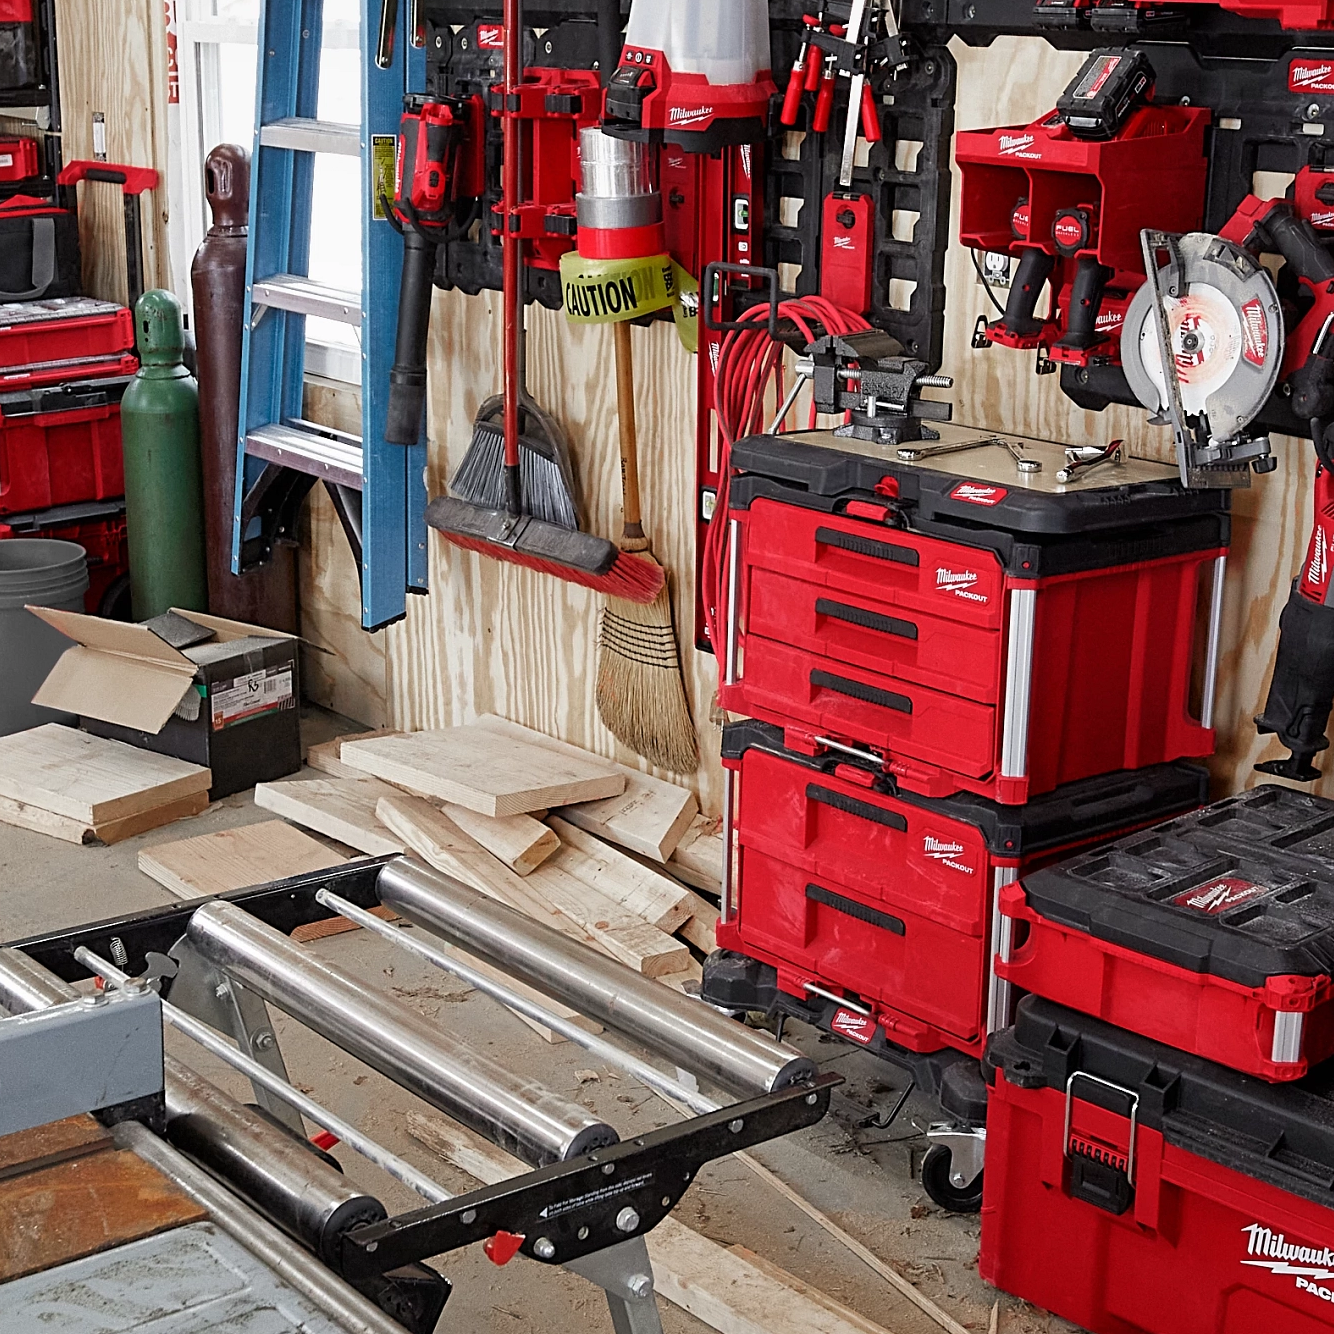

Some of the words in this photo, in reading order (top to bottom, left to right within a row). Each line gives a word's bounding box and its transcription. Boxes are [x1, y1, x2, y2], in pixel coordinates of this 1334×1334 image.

[1292, 65, 1332, 82] Milwaukee
[669, 106, 714, 121] Milwaukee
[998, 134, 1034, 151] Milwaukee
[1013, 212, 1028, 223] FUE
[1055, 225, 1079, 233] FUEL
[566, 277, 637, 317] CAUTION
[1095, 311, 1122, 325] aukee
[1308, 524, 1322, 585] Milwaukee
[935, 567, 978, 584] Milwaukee
[954, 589, 988, 603] PACKOUT
[923, 835, 964, 852] Milwaukee
[942, 858, 974, 875] PACKOUT
